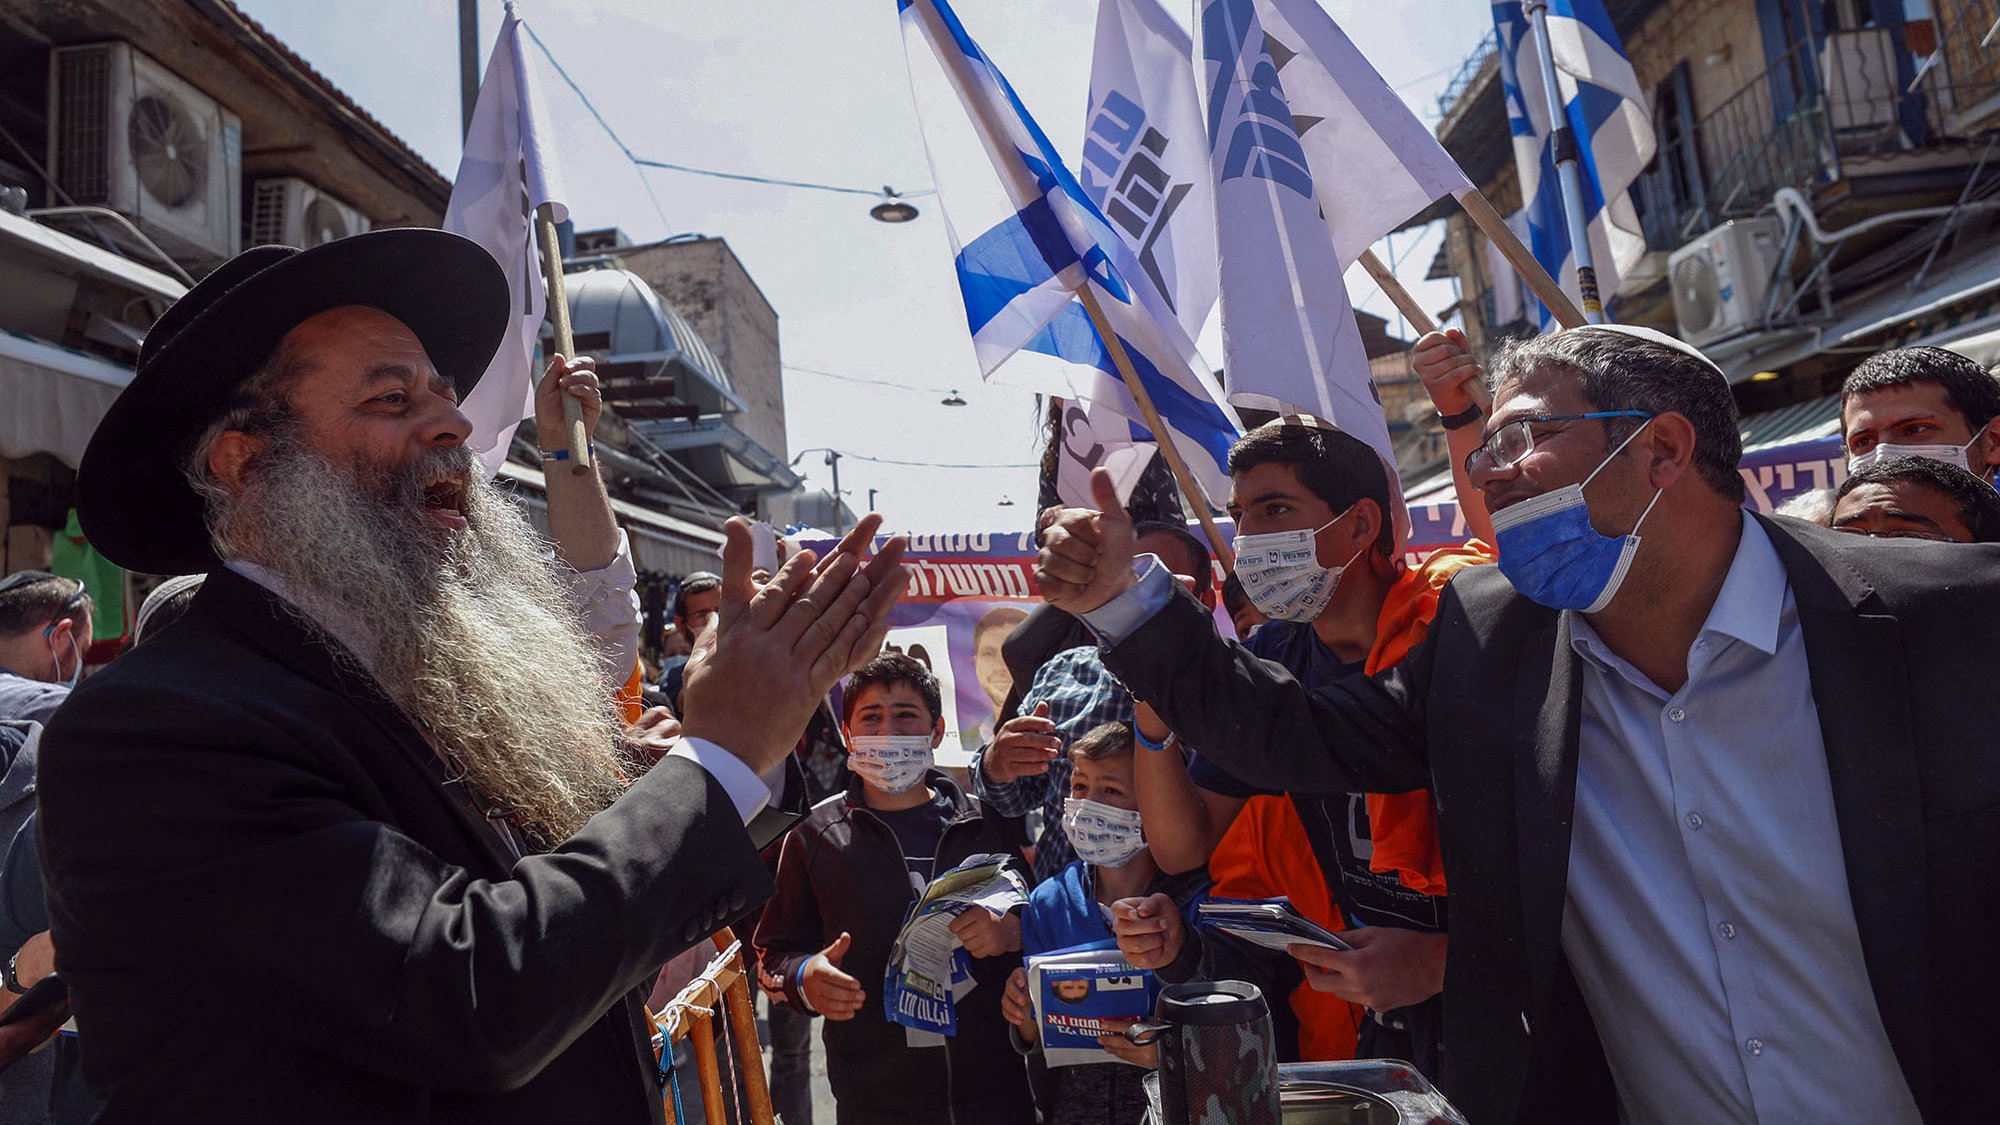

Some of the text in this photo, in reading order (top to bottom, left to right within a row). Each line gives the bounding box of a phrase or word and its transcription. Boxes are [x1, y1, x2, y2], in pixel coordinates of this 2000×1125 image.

[906, 558, 1029, 598] ממשלת
[1048, 1014, 1100, 1029] אין ממש
